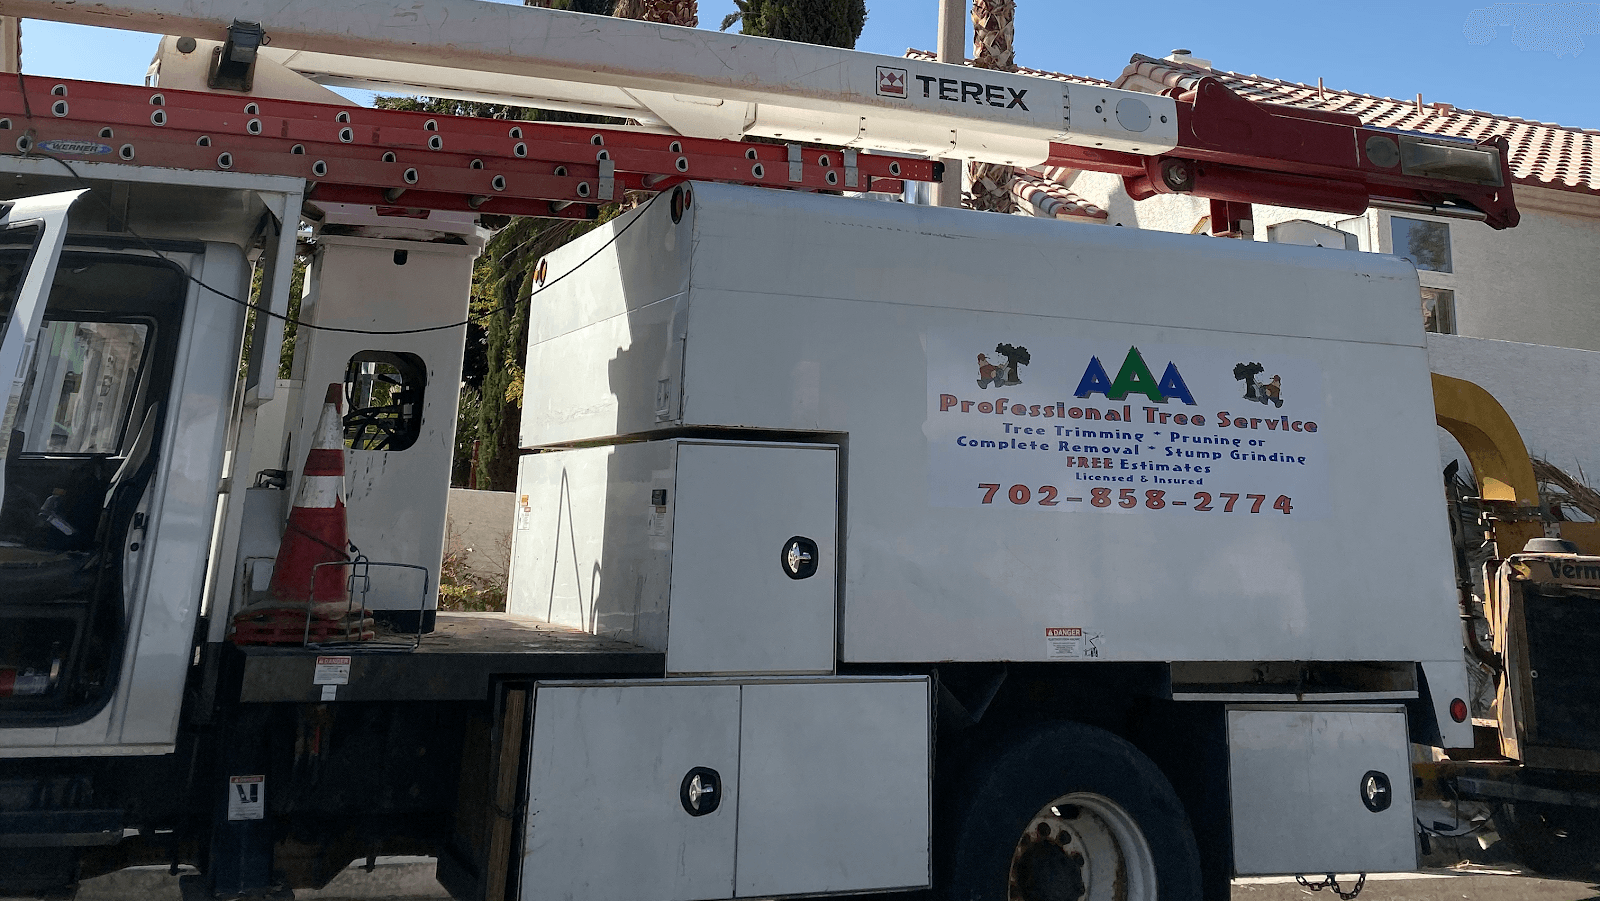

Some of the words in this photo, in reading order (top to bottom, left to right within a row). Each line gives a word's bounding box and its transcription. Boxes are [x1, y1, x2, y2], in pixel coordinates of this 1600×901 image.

[916, 75, 1029, 111] TEREX
[52, 143, 98, 152] WERNER
[1073, 345, 1198, 406] AAA
[940, 394, 1131, 422] Professional
[1143, 406, 1206, 426] Tree
[1216, 411, 1318, 433] Service
[1002, 423, 1046, 436] Tree
[1054, 425, 1144, 442] Trimming
[1170, 431, 1241, 447] Pruning
[1249, 438, 1266, 447] or
[956, 436, 1049, 451] Complete
[1058, 440, 1139, 455] Removal
[1164, 446, 1222, 460] Stump
[1230, 450, 1306, 465] Grinding
[1066, 456, 1114, 469] FREE
[1120, 458, 1211, 474] Estimates
[1075, 472, 1134, 482] Licensed
[1140, 475, 1149, 483] &
[1154, 475, 1204, 486] Insured
[978, 483, 1294, 515] 702-858-2774
